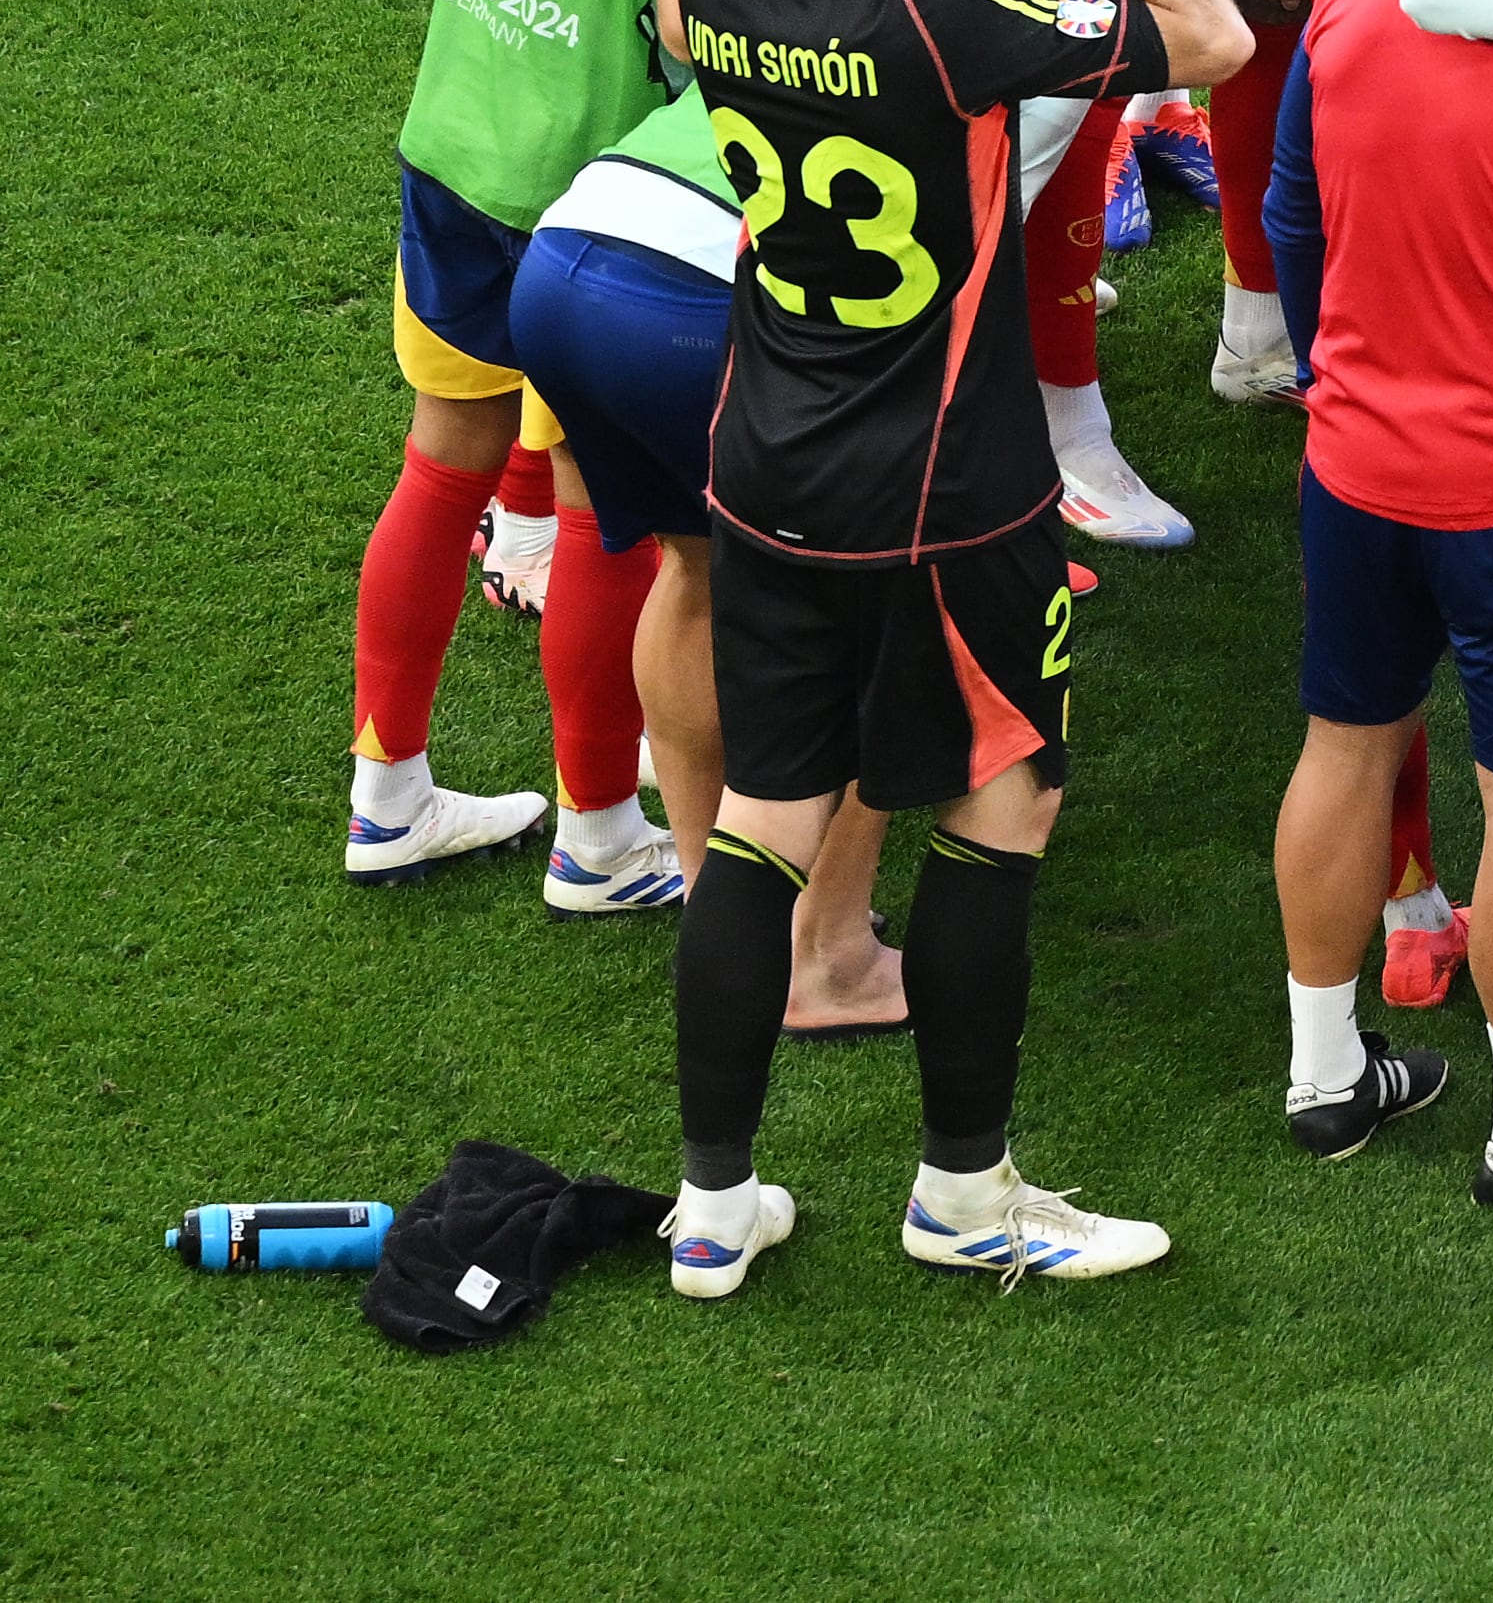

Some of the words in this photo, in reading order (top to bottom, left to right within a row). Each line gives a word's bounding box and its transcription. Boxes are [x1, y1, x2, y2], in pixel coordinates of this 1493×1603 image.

[688, 14, 752, 79] UNAI
[757, 38, 878, 97] SIMÓN
[710, 106, 941, 329] 23
